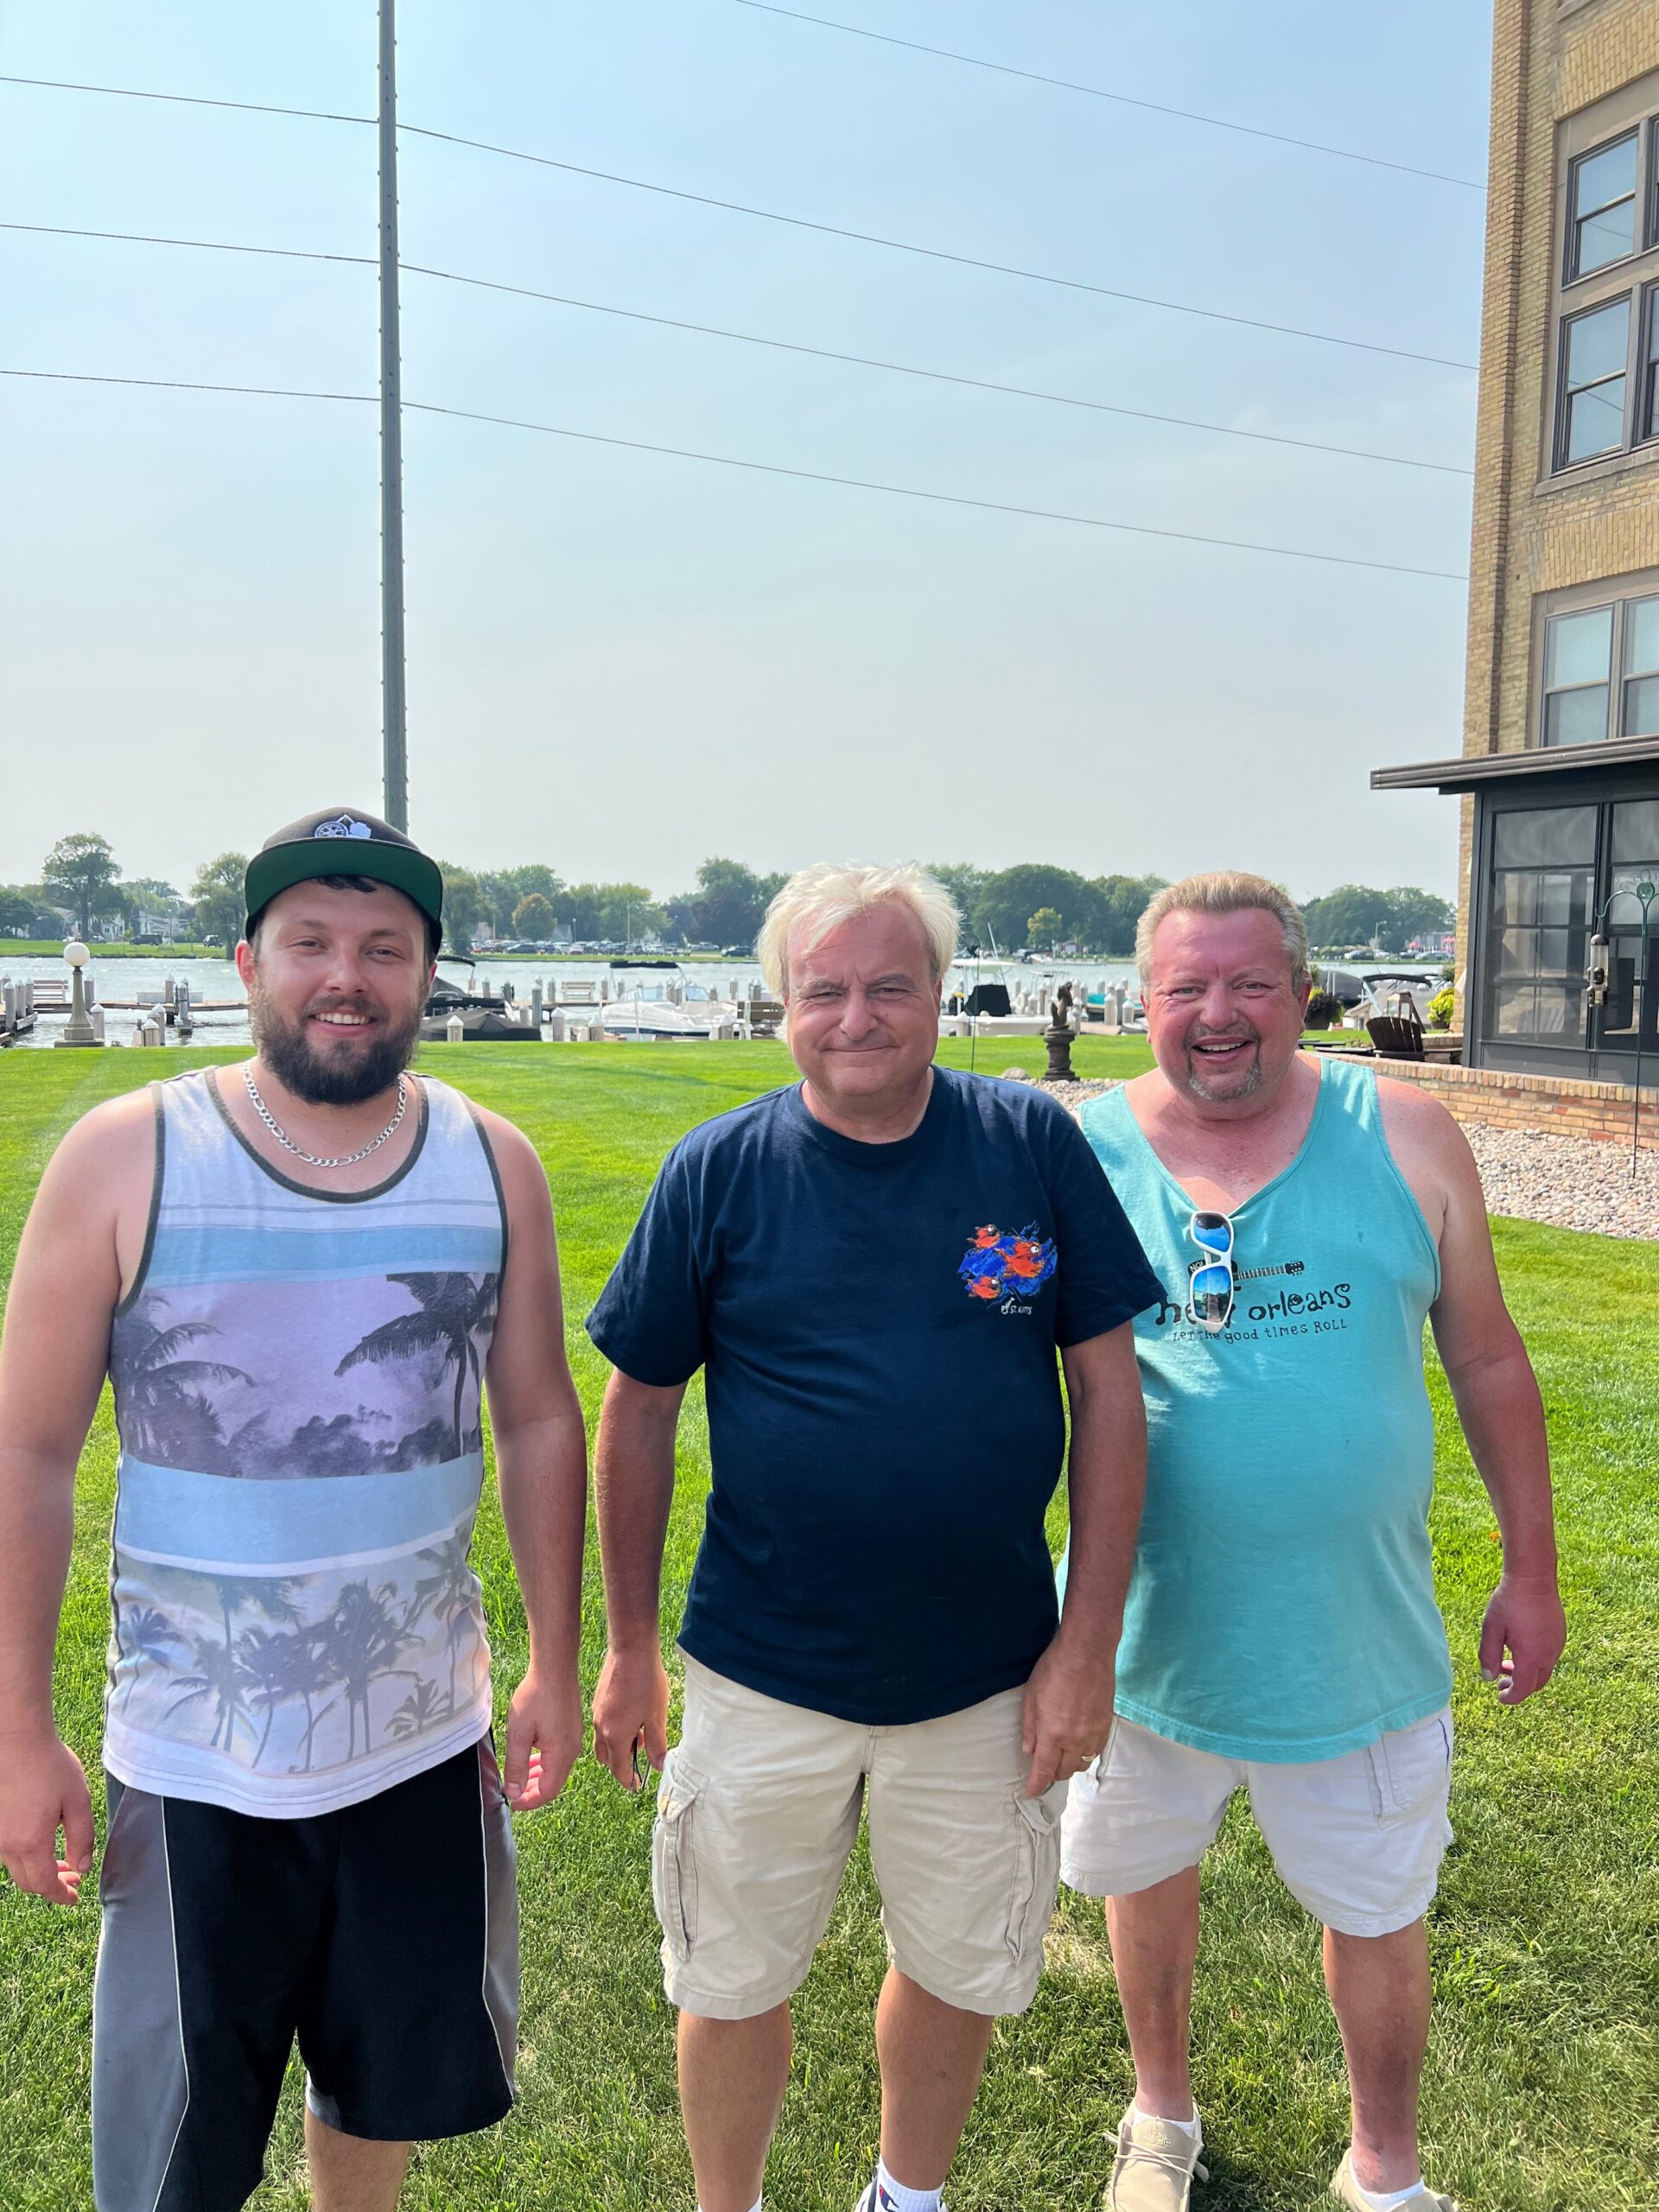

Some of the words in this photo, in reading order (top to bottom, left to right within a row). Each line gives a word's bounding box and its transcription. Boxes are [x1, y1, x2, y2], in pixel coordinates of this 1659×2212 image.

[1249, 1283, 1351, 1320] orleans
[1224, 1328, 1259, 1344] good
[1263, 1324, 1308, 1338] times
